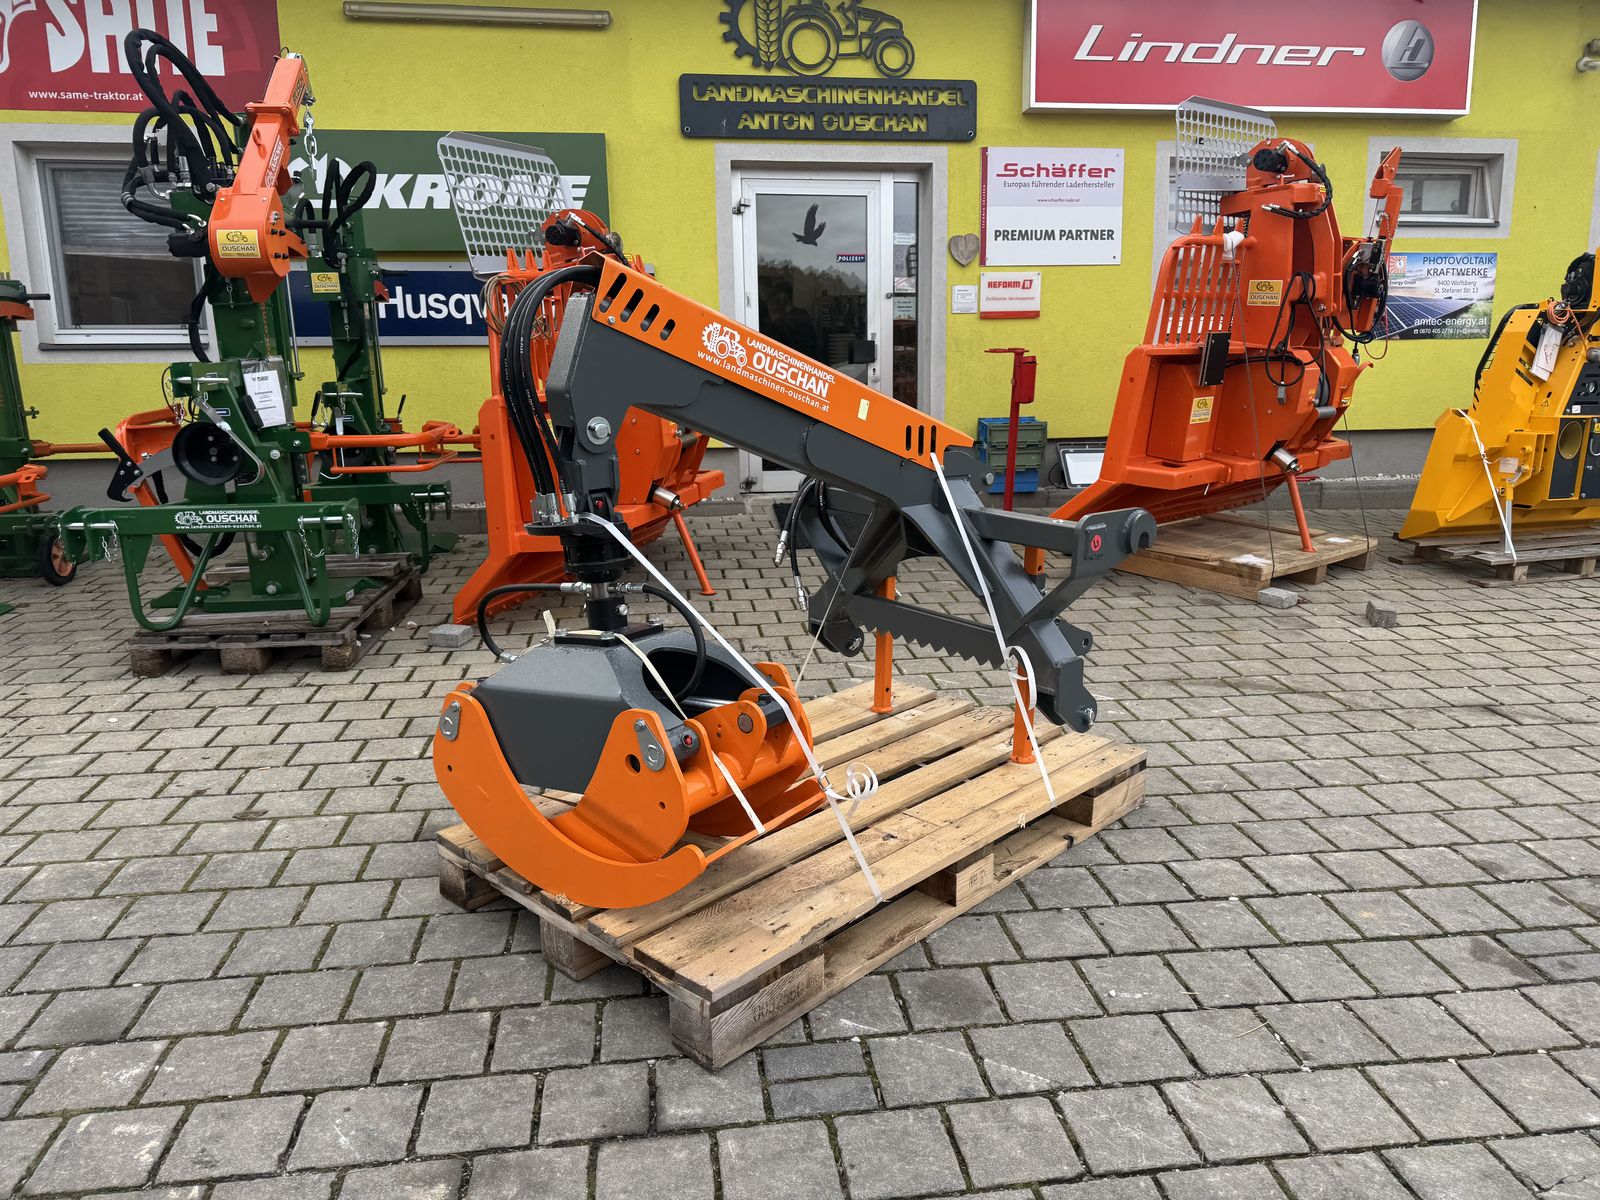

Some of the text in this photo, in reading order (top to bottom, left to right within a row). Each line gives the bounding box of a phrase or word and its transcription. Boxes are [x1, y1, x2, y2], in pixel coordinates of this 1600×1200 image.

[1073, 24, 1366, 67] Lindner
[28, 90, 144, 101] www.same-traktor.at
[692, 82, 969, 107] LANDMASCHINENHANDEL
[737, 111, 928, 133] ANTON OUSCHAN
[996, 163, 1116, 178] Schäffer
[1003, 180, 1115, 190] Europas führender Laderhersteller
[994, 229, 1115, 241] PREMIUM PARTNER
[1422, 256, 1494, 266] PHOTOVOLTAIK
[1426, 268, 1488, 277] KRAFTWERKE
[1414, 317, 1487, 327] amtec-energy.at
[746, 336, 836, 385] LANDMASCHINENHANDEL
[752, 351, 830, 398] OUSCHAN
[697, 350, 830, 413] www.landmaschinen-ouschan.at
[206, 514, 257, 523] OUSCHAN
